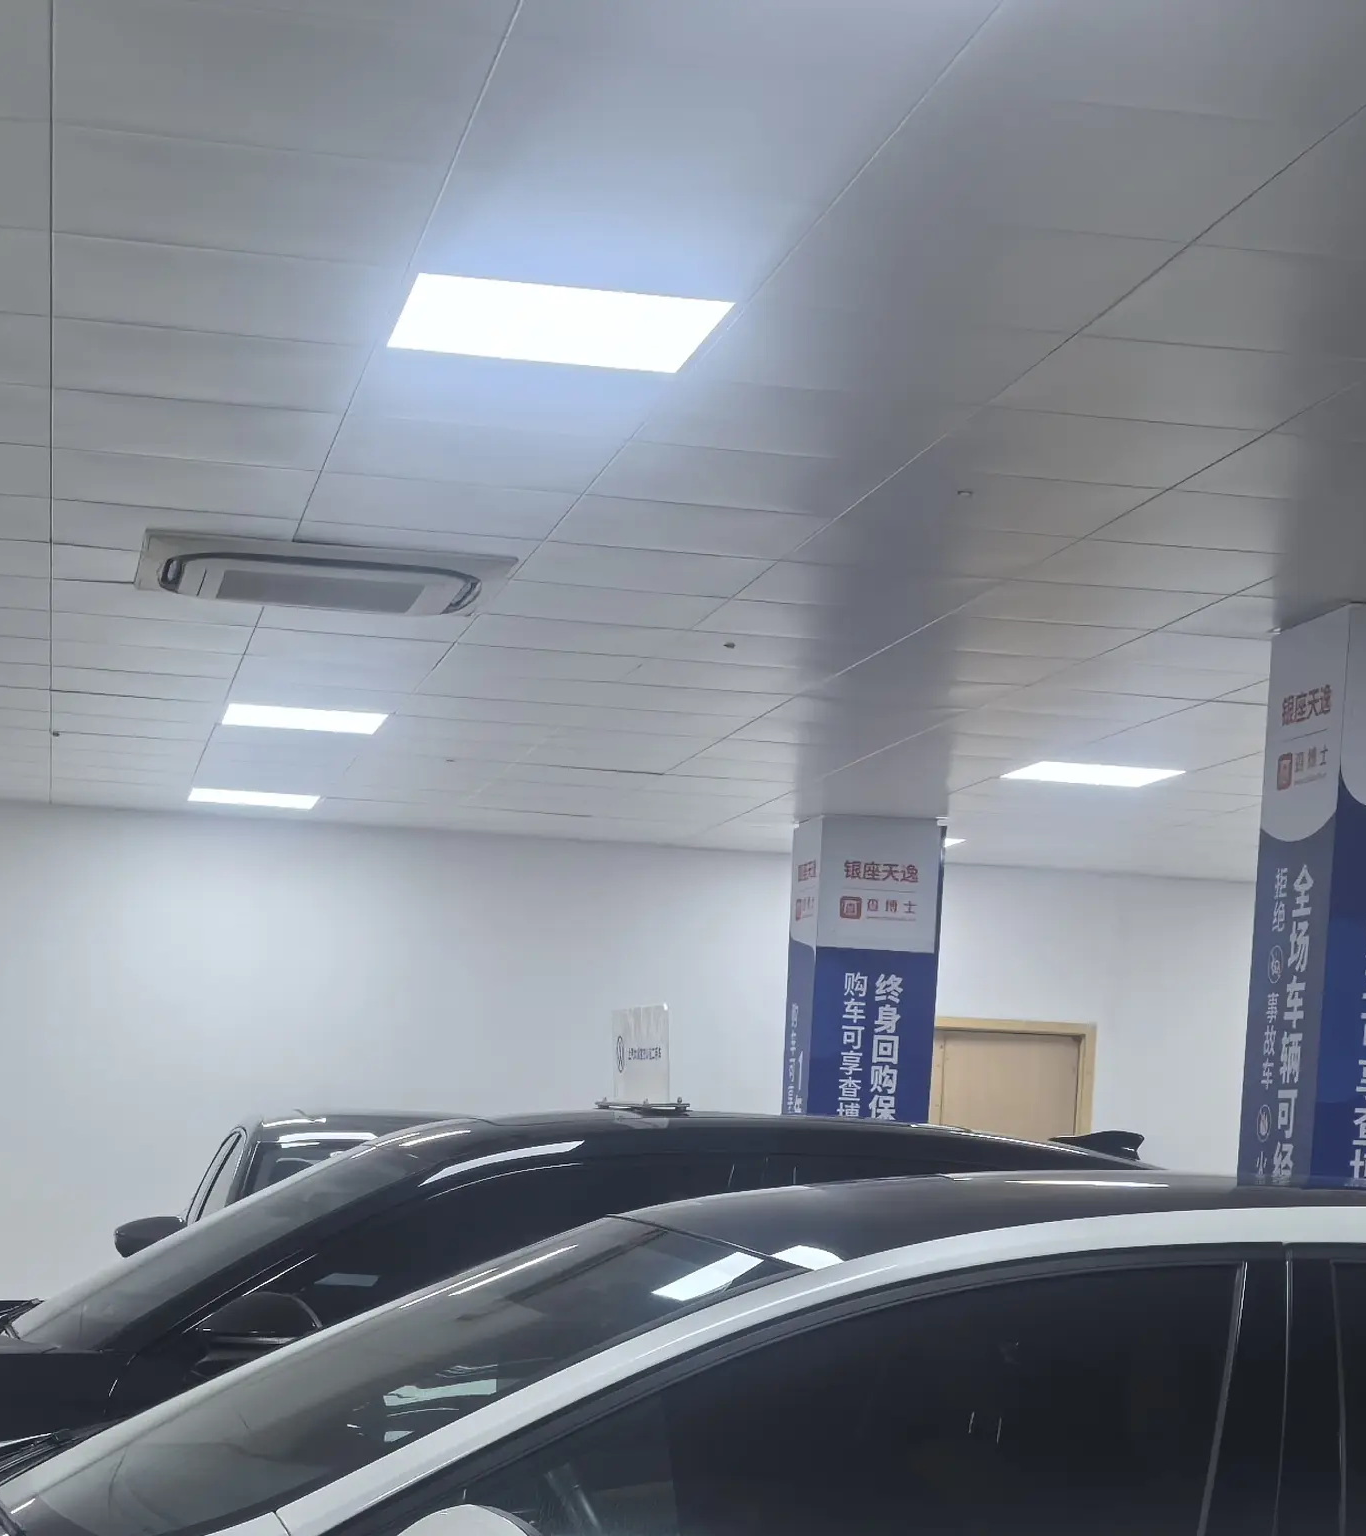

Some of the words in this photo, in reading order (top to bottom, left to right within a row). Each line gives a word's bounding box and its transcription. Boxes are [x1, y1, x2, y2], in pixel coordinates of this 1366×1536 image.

[843, 860, 919, 883] 银座天逸
[868, 973, 904, 1120] 终身回购保
[1261, 991, 1279, 1090] 事故车
